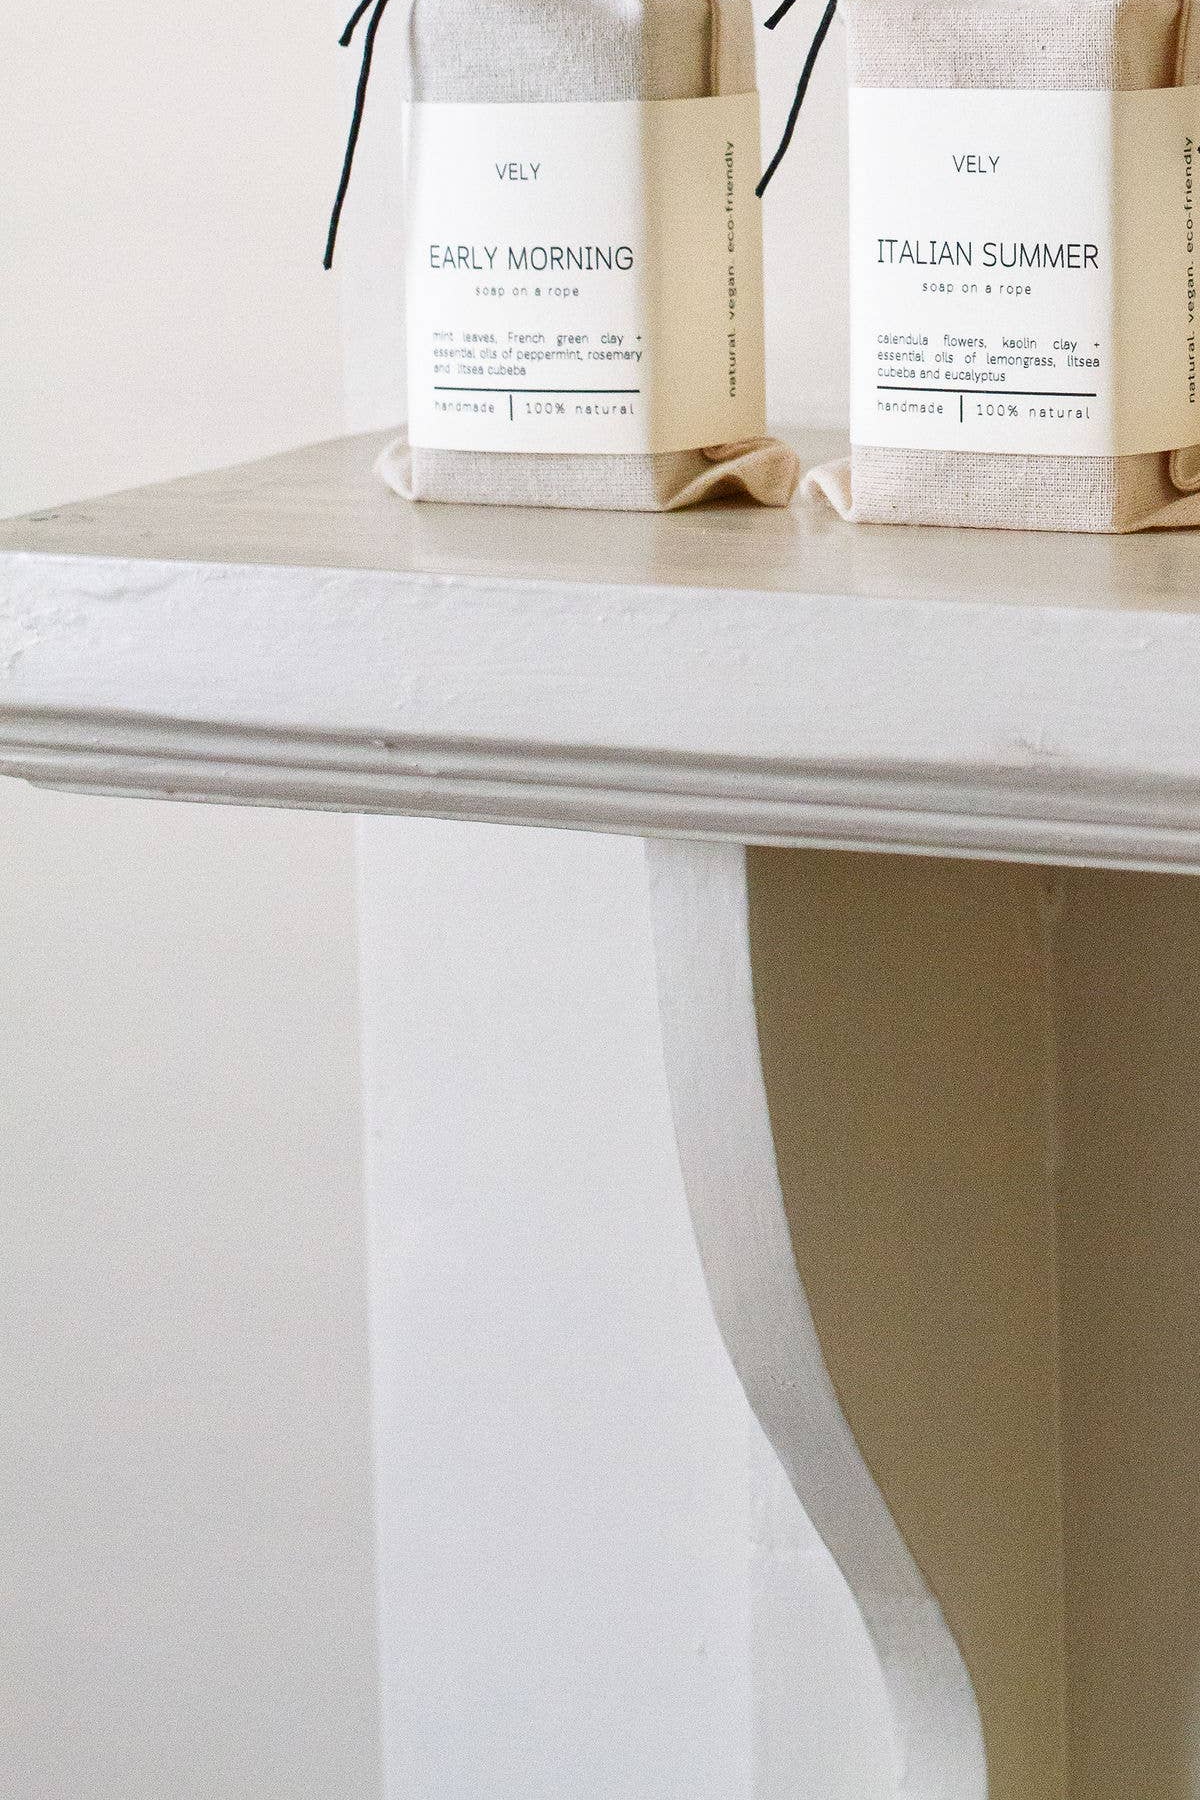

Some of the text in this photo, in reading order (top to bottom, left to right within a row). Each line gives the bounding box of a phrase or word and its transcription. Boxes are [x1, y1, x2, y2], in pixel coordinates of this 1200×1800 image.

[495, 163, 541, 181] VELY
[952, 155, 1000, 174] VELY
[726, 140, 735, 253] eco-friendly
[1184, 137, 1194, 253] eco-friendly
[429, 245, 634, 271] EARLY MORNING
[877, 239, 1099, 270] ITALIAN SUMMER
[475, 285, 579, 298] soap on a rope
[922, 281, 1031, 297] soap on a rope
[508, 332, 545, 343] French
[557, 334, 588, 346] green
[601, 333, 624, 346] clay
[877, 333, 929, 346] calendula
[944, 334, 987, 348] flowers,
[1002, 337, 1037, 349] kaolin
[1053, 338, 1078, 353] clay
[434, 348, 642, 361] essential oils of peppermint, rosemary
[877, 350, 1100, 368] essential oils of lemongrass, litsea
[434, 363, 527, 376] and litsea cubeba
[877, 367, 1006, 383] cubeba and eucalyptus
[435, 401, 495, 413] handmade
[525, 403, 635, 415] 100% natural
[877, 400, 944, 414] handmade
[976, 404, 1090, 419] 100% natural
